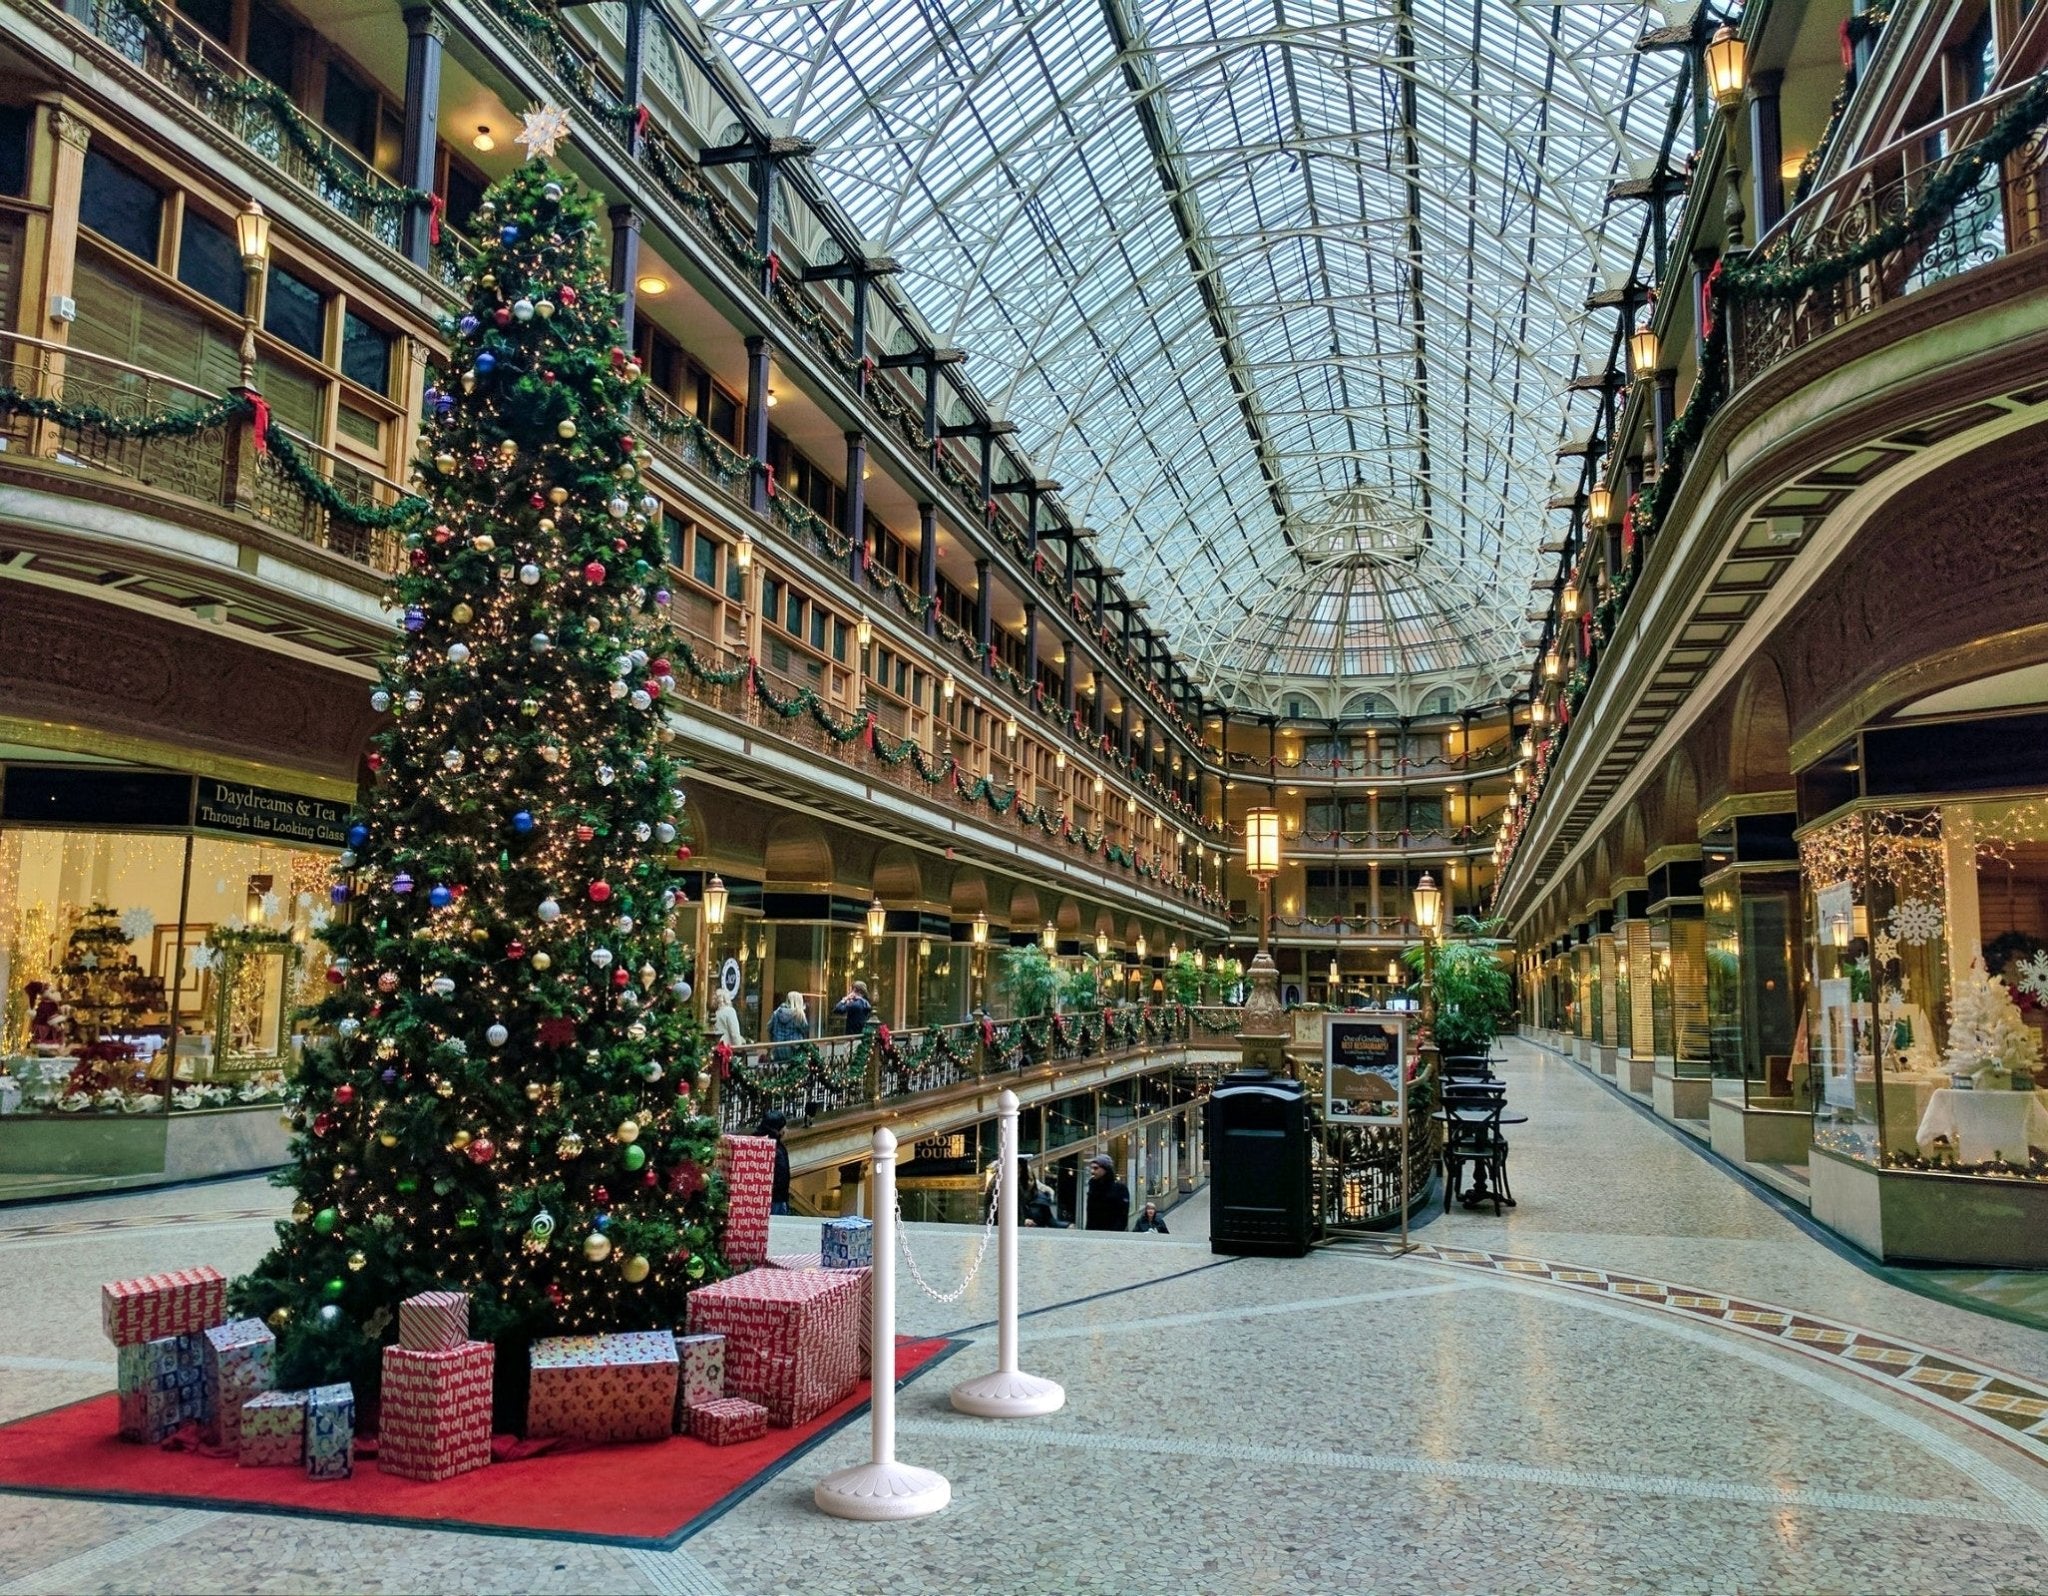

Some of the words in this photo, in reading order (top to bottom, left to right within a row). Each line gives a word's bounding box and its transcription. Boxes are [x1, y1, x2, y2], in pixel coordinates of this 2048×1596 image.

[216, 784, 293, 813] Daydreams
[296, 800, 310, 816] &
[313, 802, 336, 821] Tea
[201, 806, 249, 828] Through
[253, 815, 270, 829] the
[273, 817, 314, 839] Looking
[317, 826, 345, 841] Glass
